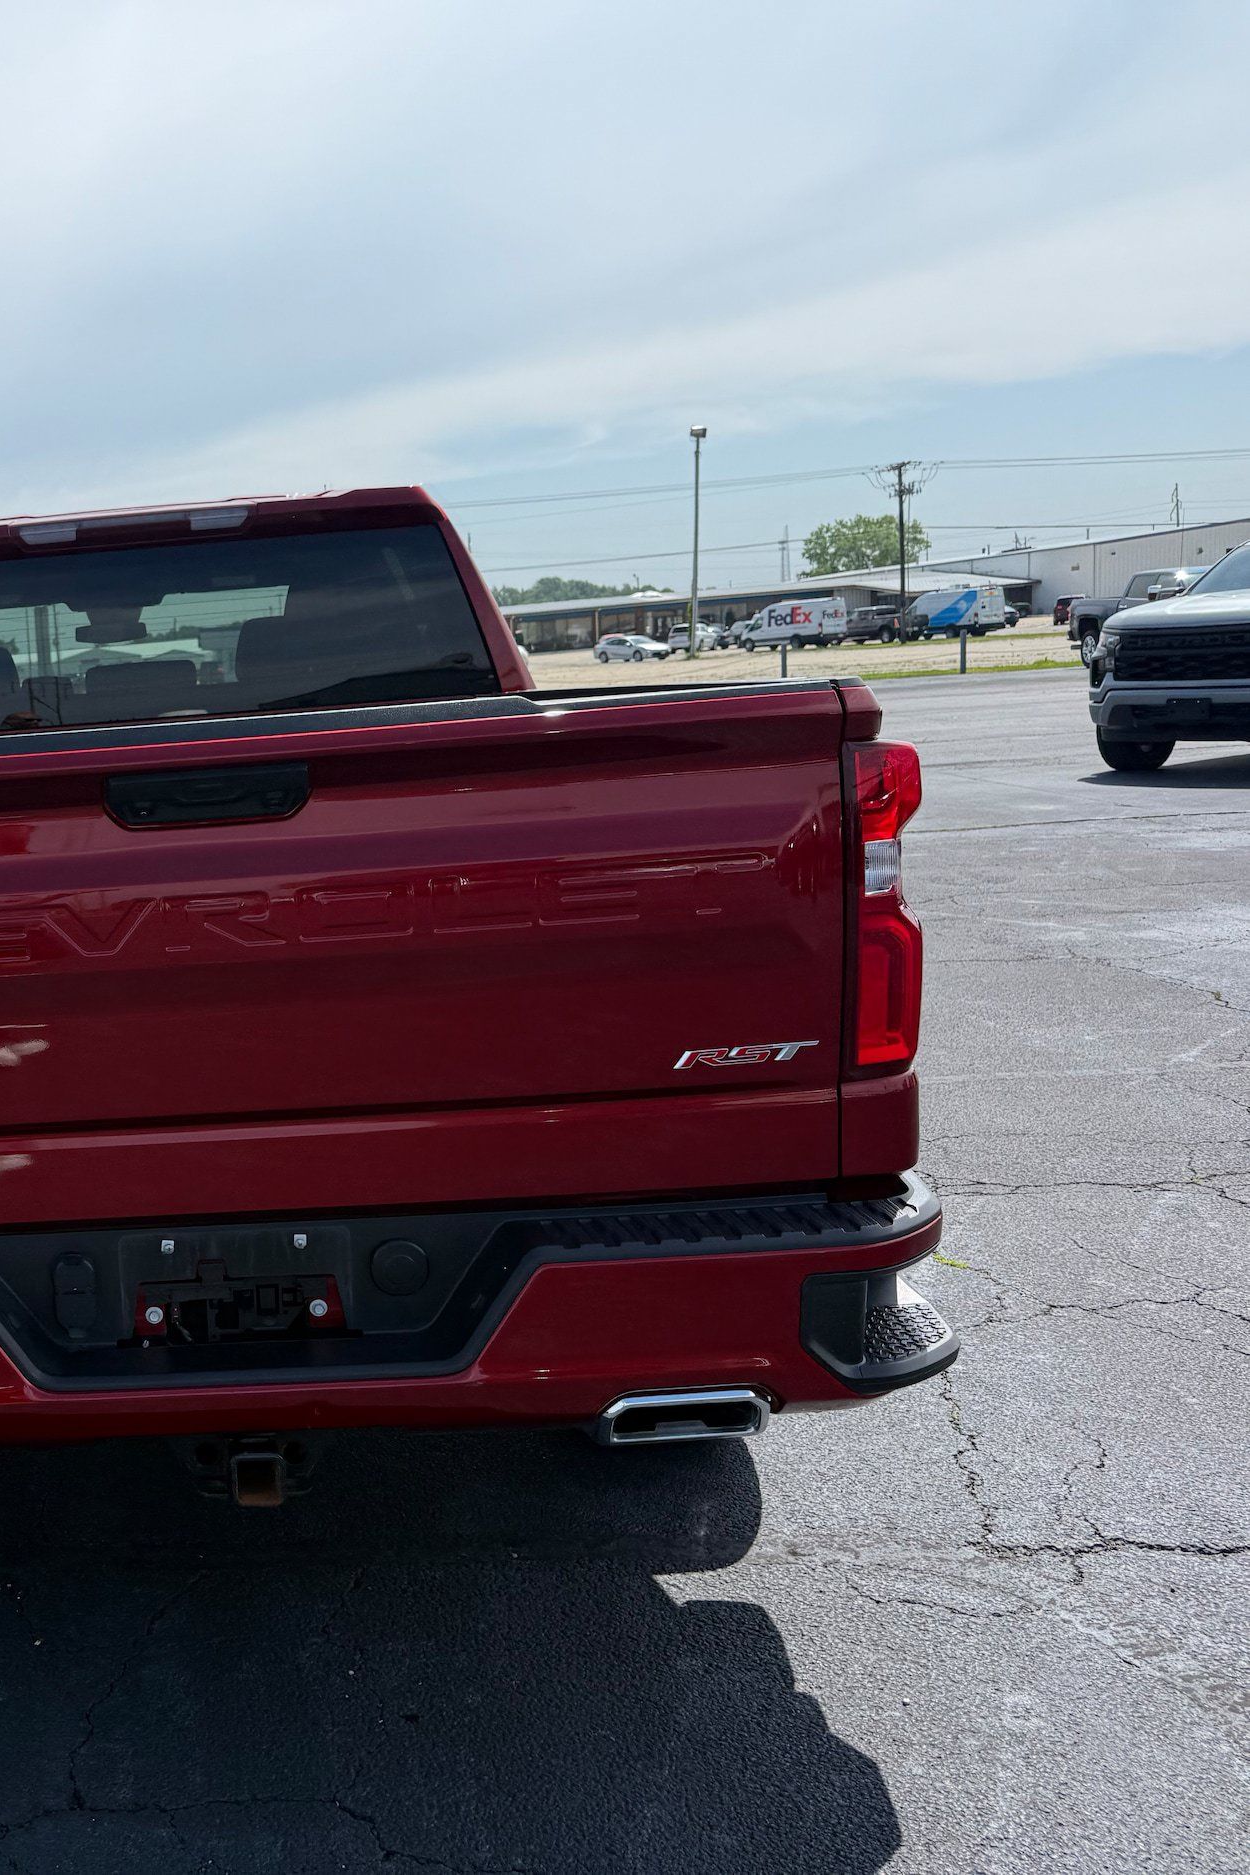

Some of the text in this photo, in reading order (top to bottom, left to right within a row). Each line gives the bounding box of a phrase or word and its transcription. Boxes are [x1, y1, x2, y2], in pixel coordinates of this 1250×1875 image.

[767, 606, 813, 627] FedEx
[822, 609, 845, 620] FedEx
[673, 1040, 820, 1070] RST
